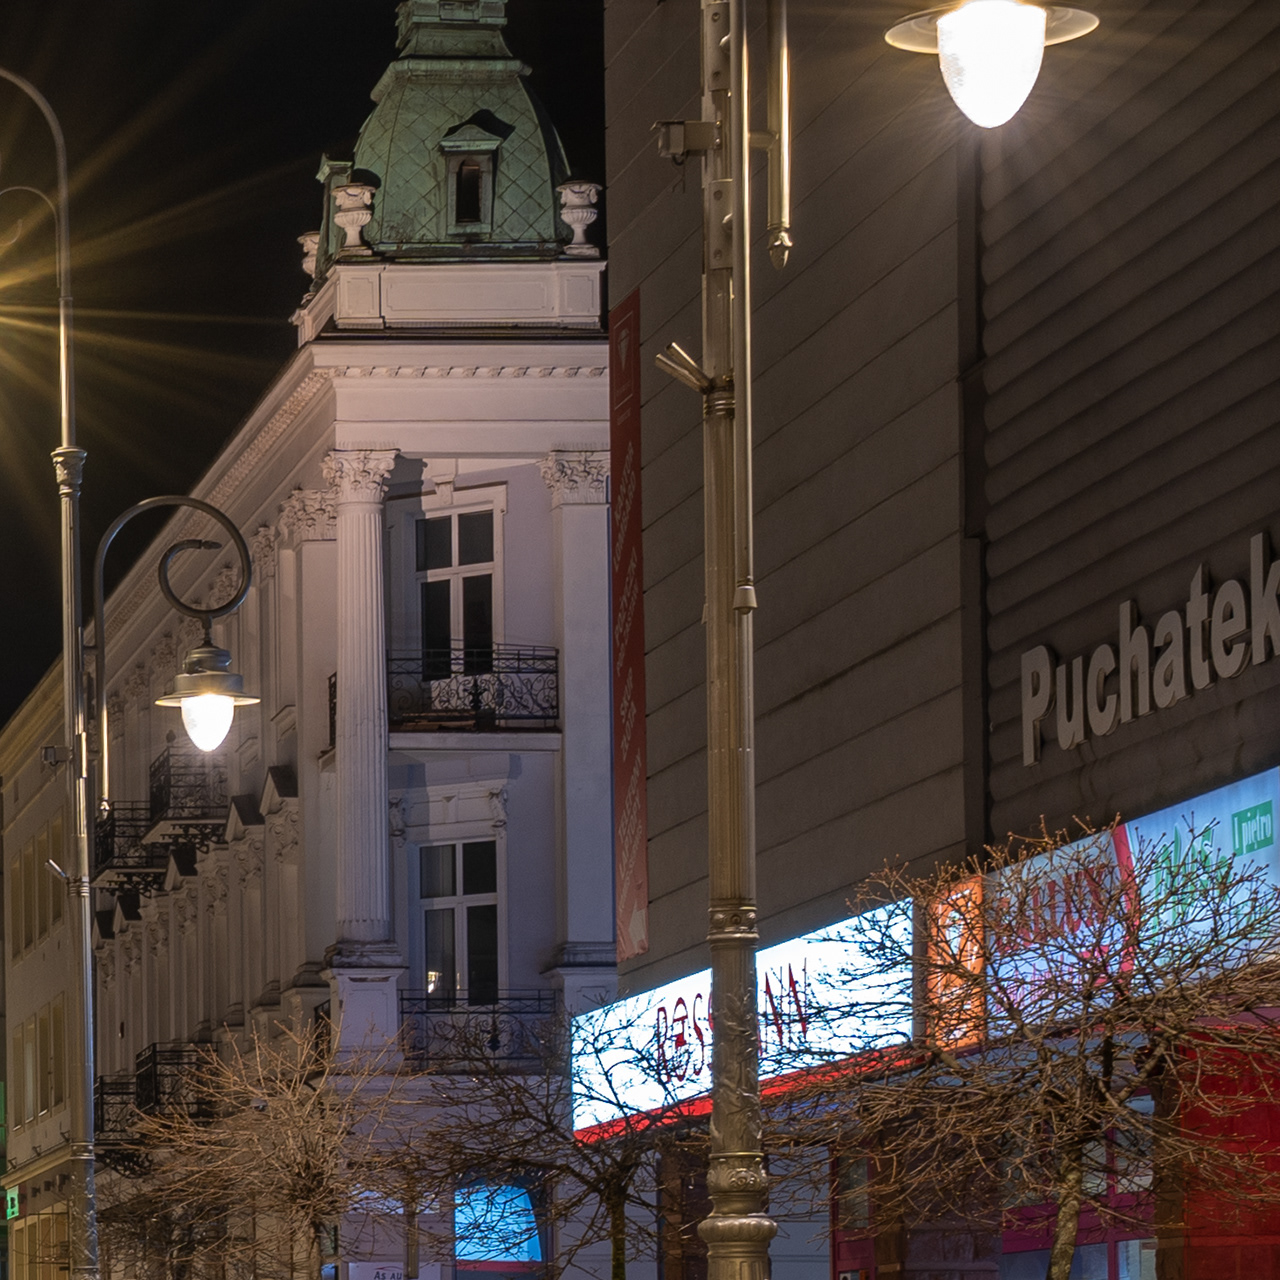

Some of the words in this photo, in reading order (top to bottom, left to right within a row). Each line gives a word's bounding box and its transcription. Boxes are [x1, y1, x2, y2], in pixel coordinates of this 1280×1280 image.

[613, 470, 637, 572] LOMBARD
[1021, 532, 1280, 767] Puchatek
[1242, 809, 1272, 855] piętro
[657, 957, 807, 1083] ROSNN
